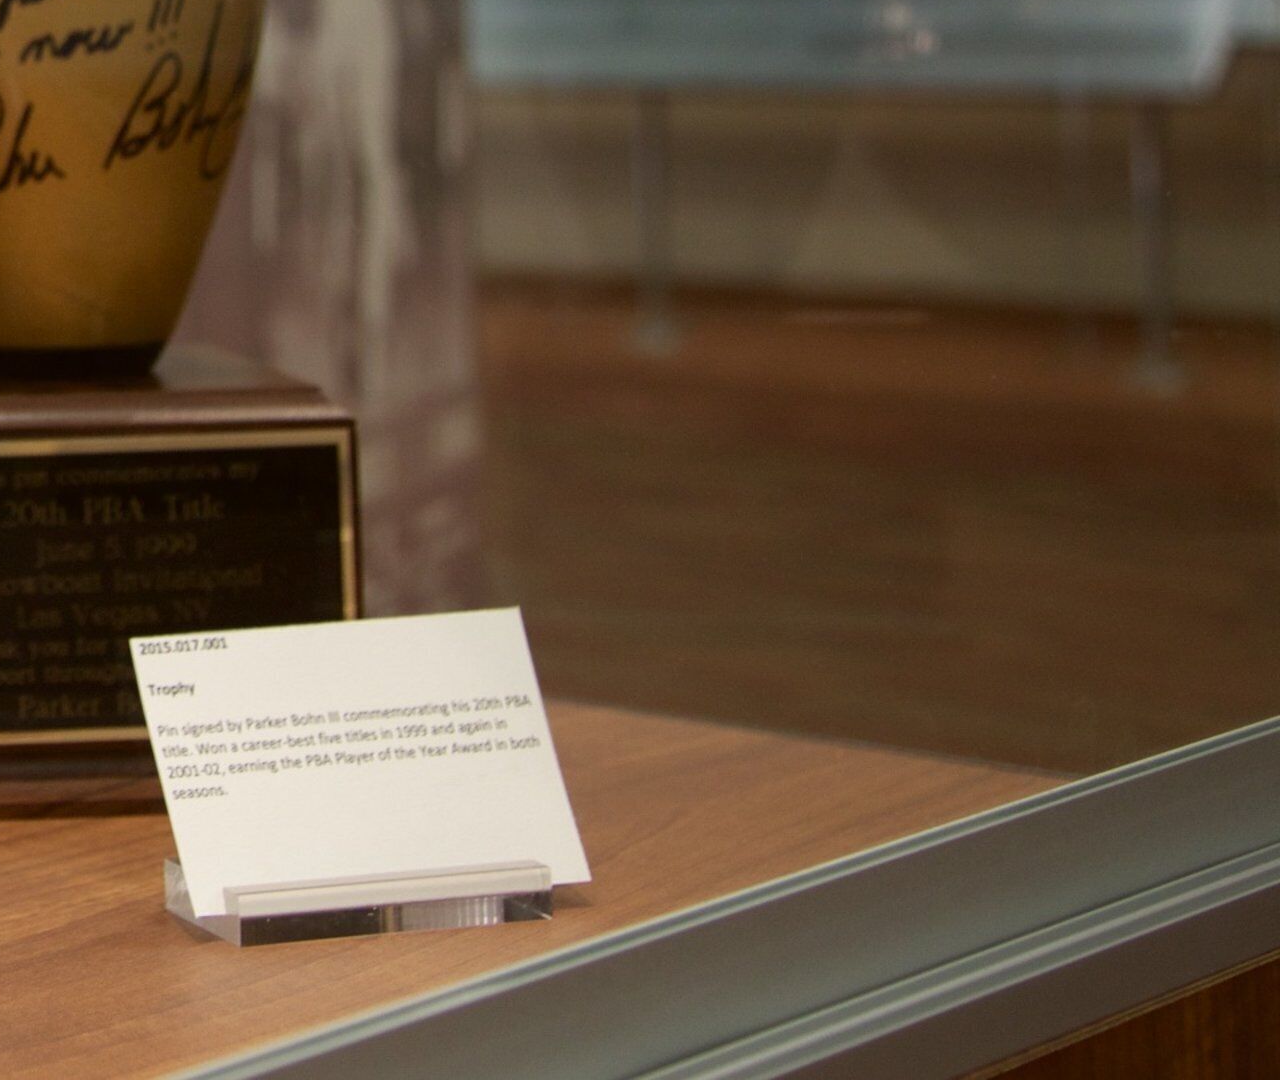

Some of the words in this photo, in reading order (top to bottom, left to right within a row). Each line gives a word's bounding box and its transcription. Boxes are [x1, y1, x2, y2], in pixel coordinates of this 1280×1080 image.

[1, 497, 67, 528] 20th
[83, 494, 145, 526] PBA
[164, 492, 225, 522] Title
[35, 538, 93, 569] June
[136, 531, 197, 561] 1999
[112, 564, 263, 593] Invitational
[16, 603, 62, 630] Las
[139, 637, 229, 656] 2015.017.001
[147, 682, 196, 698] Trophy
[18, 693, 100, 720] Parker
[157, 724, 179, 738] Pin
[182, 721, 224, 739] signed
[227, 719, 242, 735] by
[245, 716, 288, 730] Parker
[290, 712, 326, 727] Bohn
[328, 710, 339, 723] III
[343, 702, 450, 722] commemorating
[451, 700, 470, 713] his
[474, 697, 502, 711] 20th
[505, 694, 532, 708] PBA
[162, 745, 193, 759] title.
[195, 743, 227, 756] Won
[230, 743, 239, 754] a
[241, 733, 316, 753] career-best
[318, 731, 340, 745] five
[345, 729, 378, 743] titles
[381, 727, 393, 740] in
[396, 724, 428, 739] 1999
[431, 722, 455, 735] and
[458, 720, 493, 736] again
[495, 718, 508, 730] in
[167, 763, 226, 780] 2001-02,
[228, 758, 279, 774] earning
[280, 756, 303, 769] the
[305, 753, 332, 767] PBA
[334, 750, 376, 766] Player
[378, 748, 392, 761] of
[394, 746, 416, 759] the
[419, 743, 448, 757] Year
[451, 739, 493, 754] Award
[495, 738, 508, 751] in
[509, 734, 541, 749] both
[171, 785, 229, 801] seasons.
